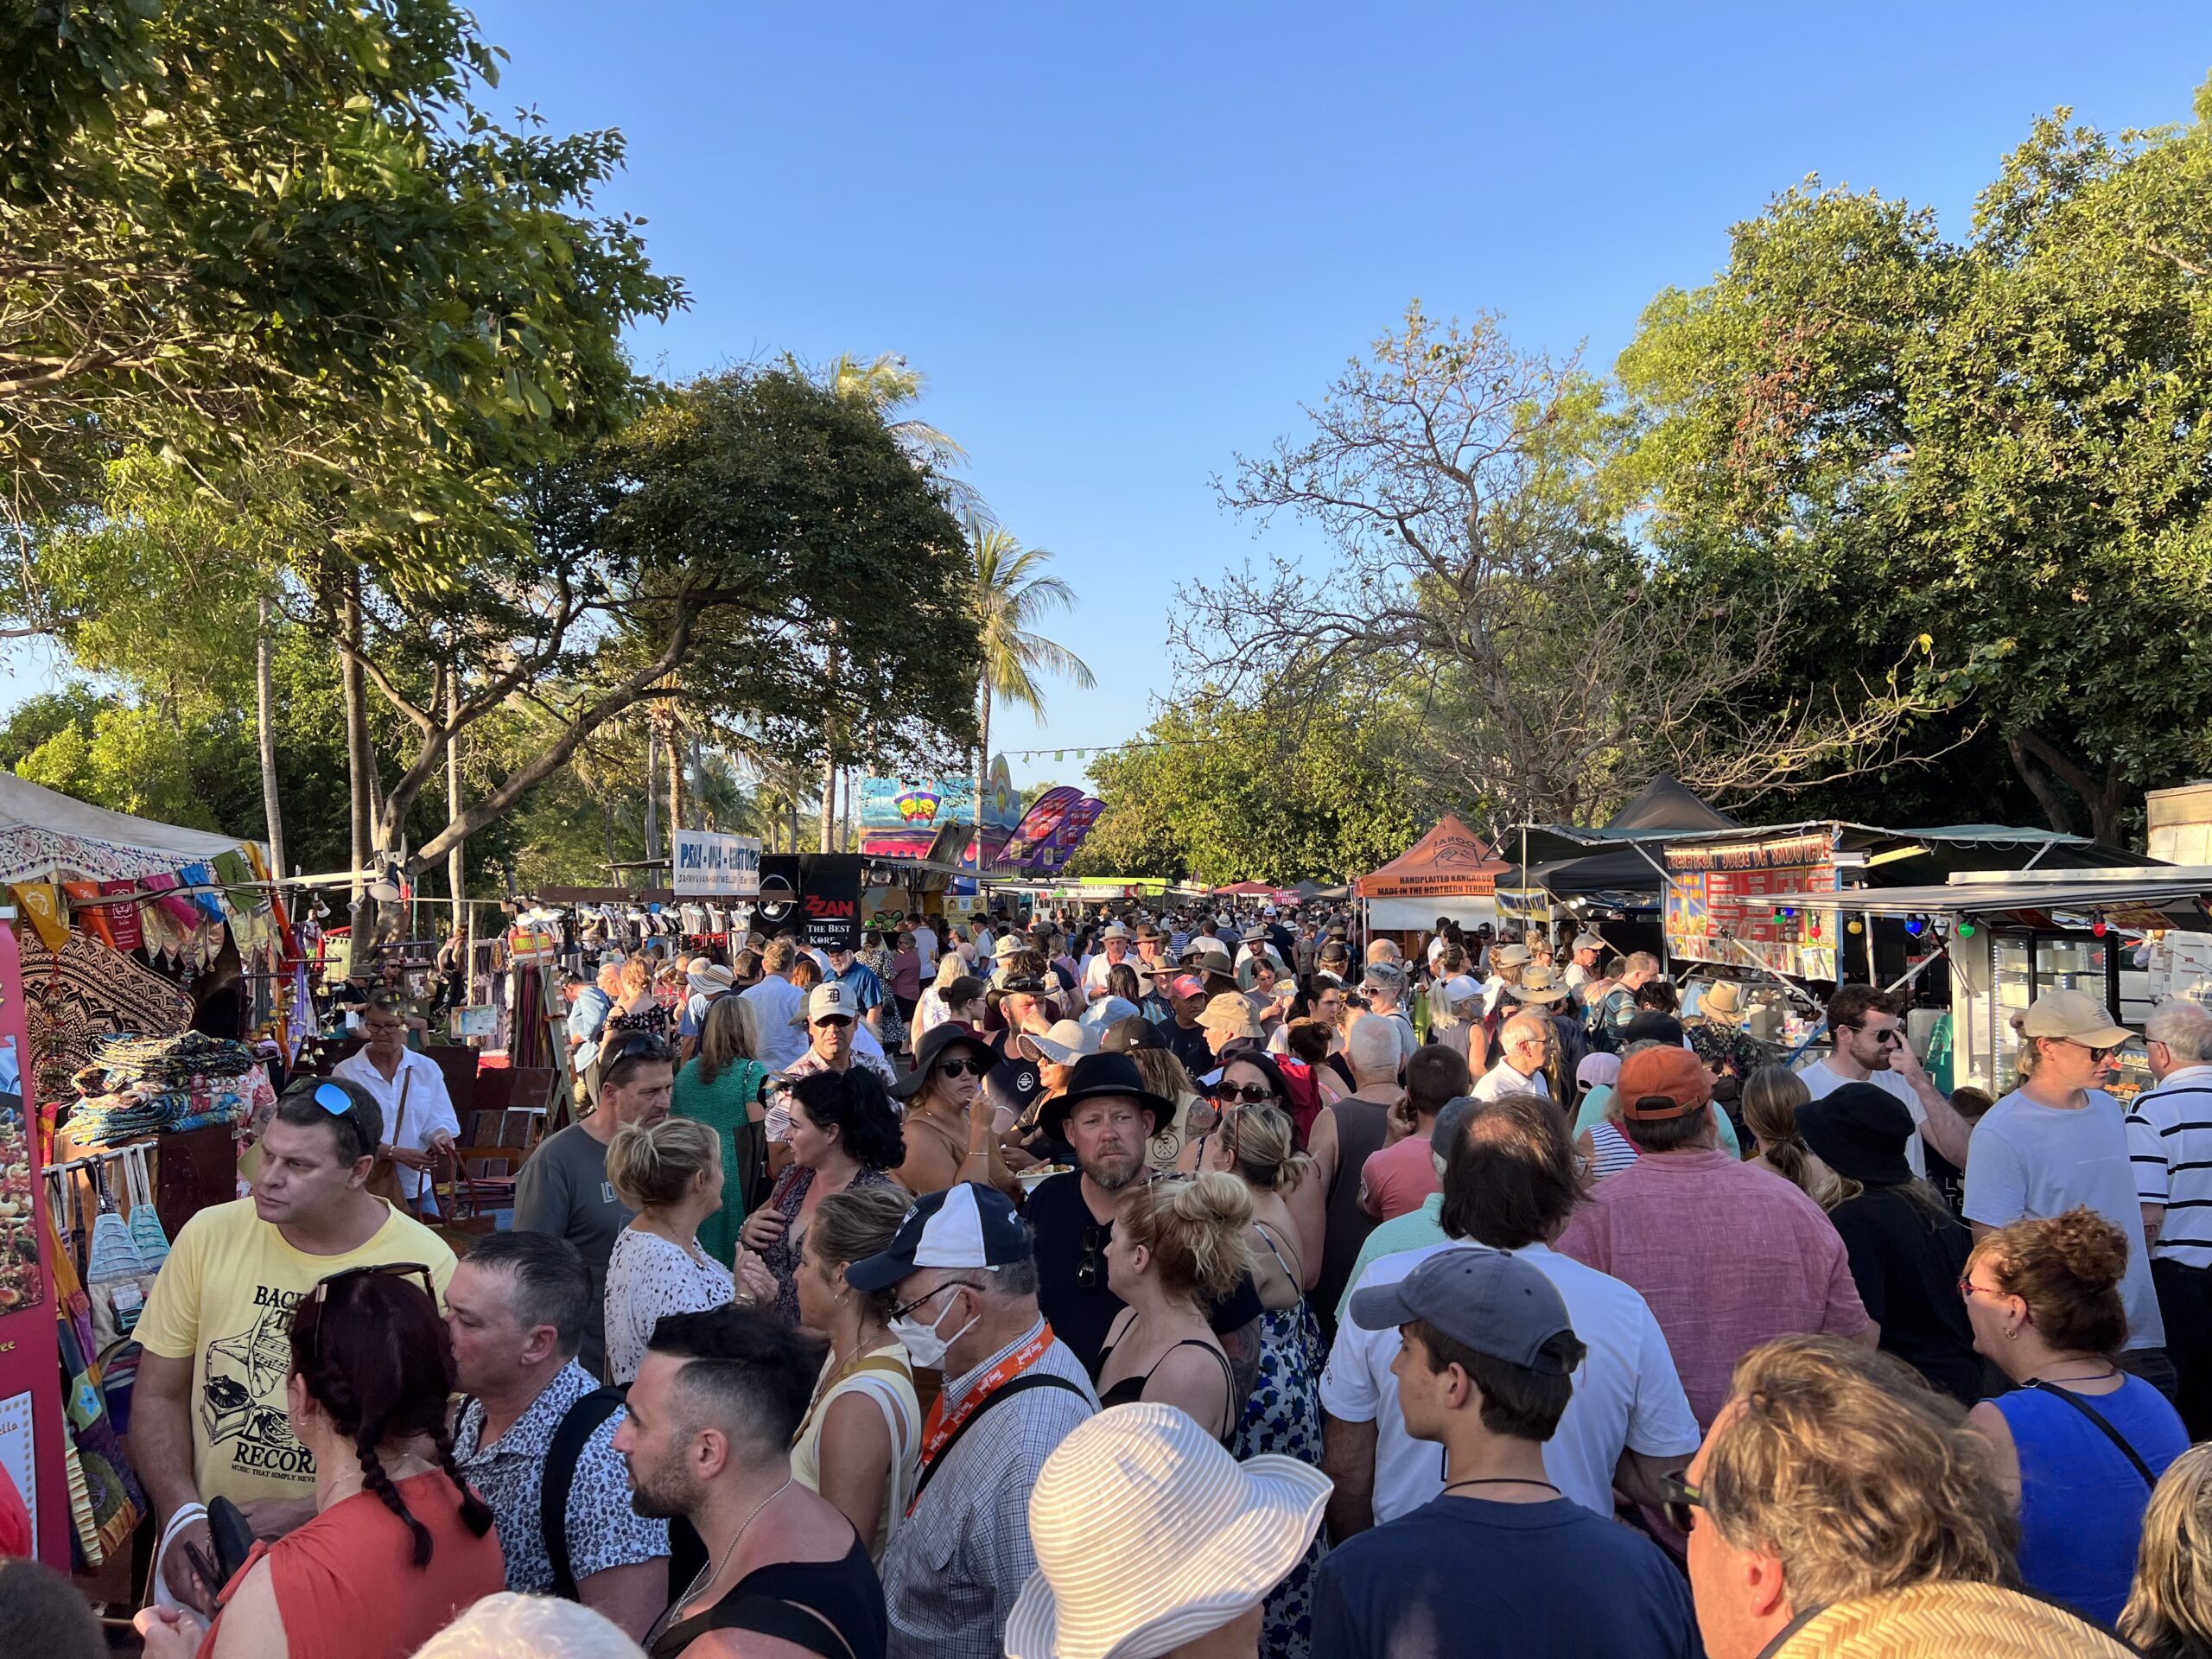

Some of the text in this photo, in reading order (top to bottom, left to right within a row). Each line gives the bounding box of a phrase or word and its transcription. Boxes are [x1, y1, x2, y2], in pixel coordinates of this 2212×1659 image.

[1433, 836, 1476, 848] JAROO
[1400, 875, 1449, 884] HANDPLAITED
[1424, 886, 1463, 894] NORTHERN
[804, 895, 854, 916] ZZAN
[828, 924, 851, 933] BEST
[232, 1464, 251, 1474] MUSIC
[252, 1468, 270, 1478] THAT
[271, 1471, 296, 1481] SIMPLY
